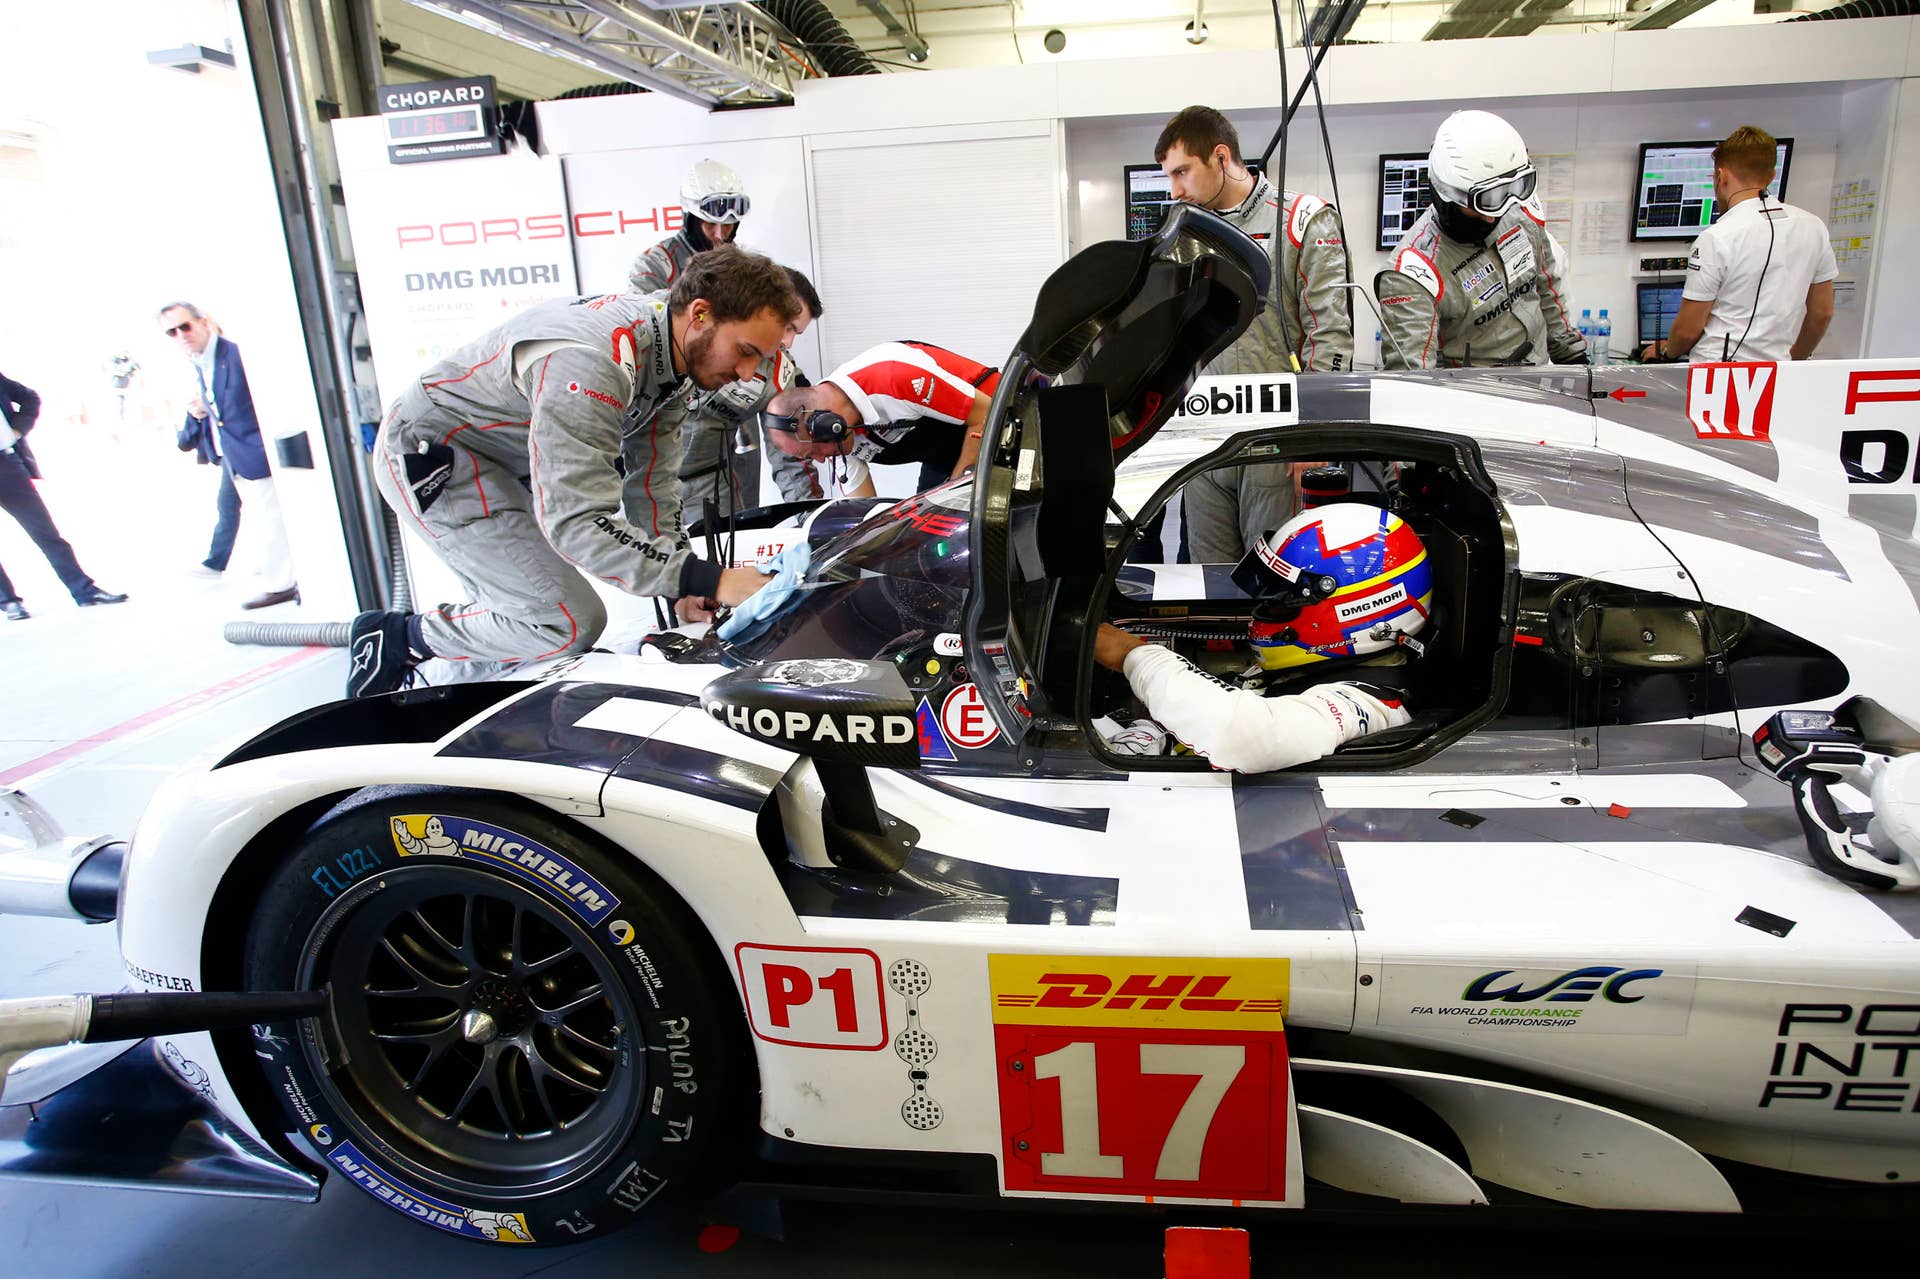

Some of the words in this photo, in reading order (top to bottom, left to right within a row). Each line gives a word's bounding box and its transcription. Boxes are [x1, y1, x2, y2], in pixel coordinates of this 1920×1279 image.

[386, 85, 485, 109] CHOPARD
[405, 270, 474, 292] DMG
[480, 264, 560, 287] MORI
[583, 388, 623, 410] vodafon
[1688, 367, 1774, 437] HY
[1840, 430, 1920, 484] D
[593, 516, 634, 545] DMG
[630, 540, 670, 565] MOR
[756, 543, 784, 557] #17
[1341, 604, 1372, 618] DMG
[1371, 590, 1403, 607] MORI
[706, 701, 915, 744] CHOPARD
[961, 705, 985, 737] E
[462, 829, 607, 913] MICHELIN
[124, 958, 195, 992] CHAEFFLER
[624, 948, 640, 965] Total
[635, 965, 661, 1009] Performance
[631, 944, 664, 989] MICHELIN
[1461, 966, 1664, 1004] WEC
[761, 962, 858, 1033] P1
[1037, 973, 1245, 1013] DHL
[1411, 1007, 1434, 1015] FIA
[1436, 1007, 1488, 1016] WORLD
[1489, 1008, 1583, 1018] ENDURANCE
[1467, 1017, 1577, 1027] CHAMPIONSHIP
[1778, 1003, 1920, 1036] PO
[1770, 1042, 1920, 1077] INT
[283, 1083, 312, 1124] MICHELIN
[1034, 1042, 1246, 1181] 17
[1758, 1081, 1920, 1113] PE
[335, 1153, 465, 1231] MICHELIN
